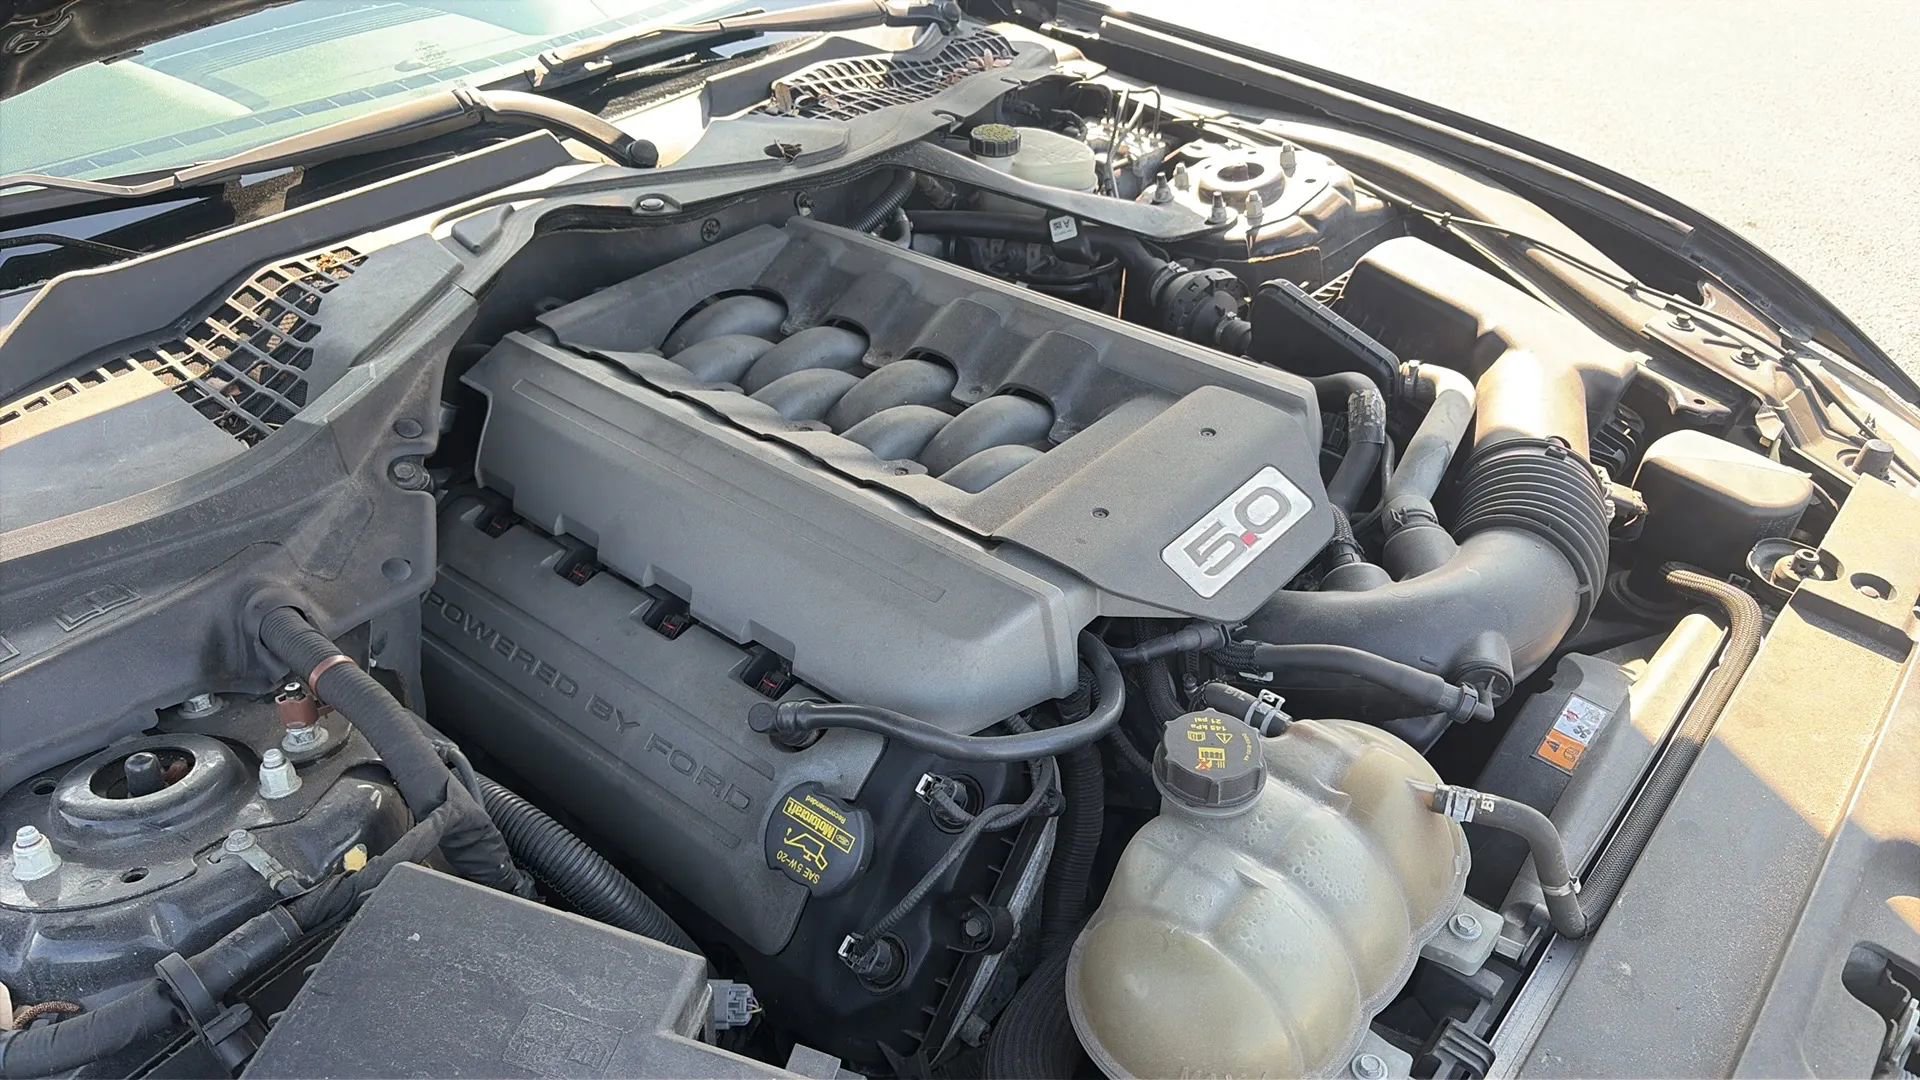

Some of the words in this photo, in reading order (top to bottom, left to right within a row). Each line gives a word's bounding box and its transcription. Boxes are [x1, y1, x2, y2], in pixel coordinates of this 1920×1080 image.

[1183, 486, 1292, 577] 5.0
[420, 588, 579, 698] POWERED
[584, 694, 641, 736] BY
[643, 732, 752, 814] FORD
[786, 800, 836, 840] Motorcraft
[805, 794, 847, 825] Recommended
[802, 867, 821, 885] SAE
